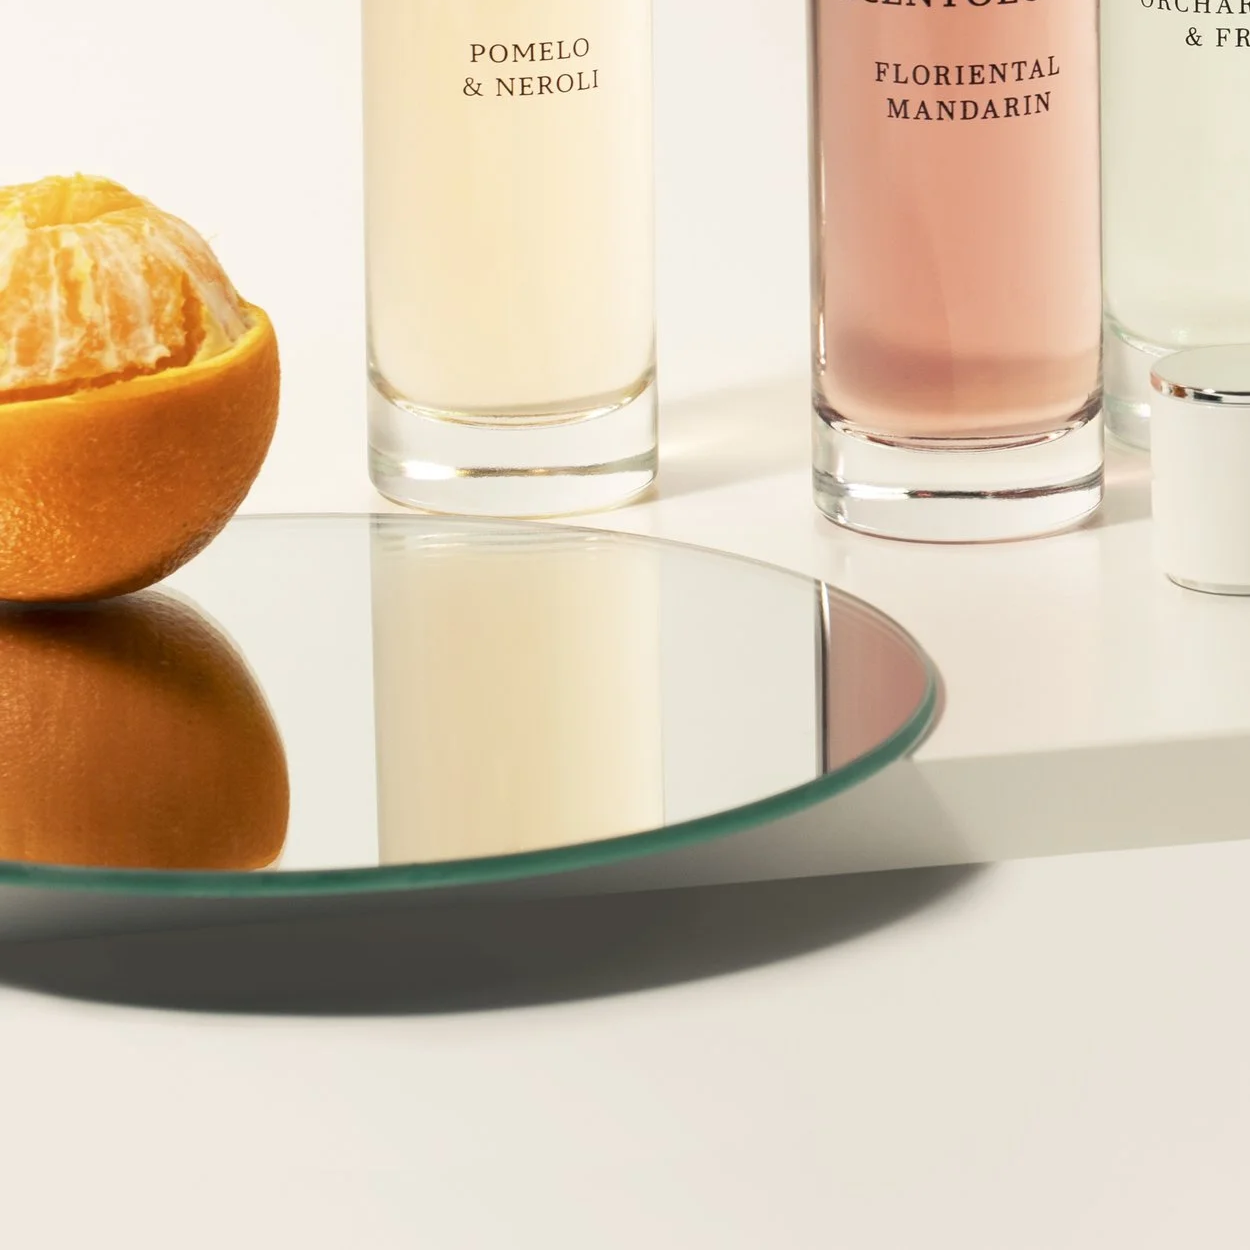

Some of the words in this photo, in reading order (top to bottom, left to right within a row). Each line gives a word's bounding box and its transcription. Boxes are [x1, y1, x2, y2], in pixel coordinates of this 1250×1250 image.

[469, 37, 590, 64] POMELO
[1184, 26, 1204, 47] &
[462, 76, 485, 97] &
[495, 68, 599, 97] NEROLI
[874, 55, 1061, 87] FLORIENTAL
[886, 90, 1052, 121] MANDARIN
